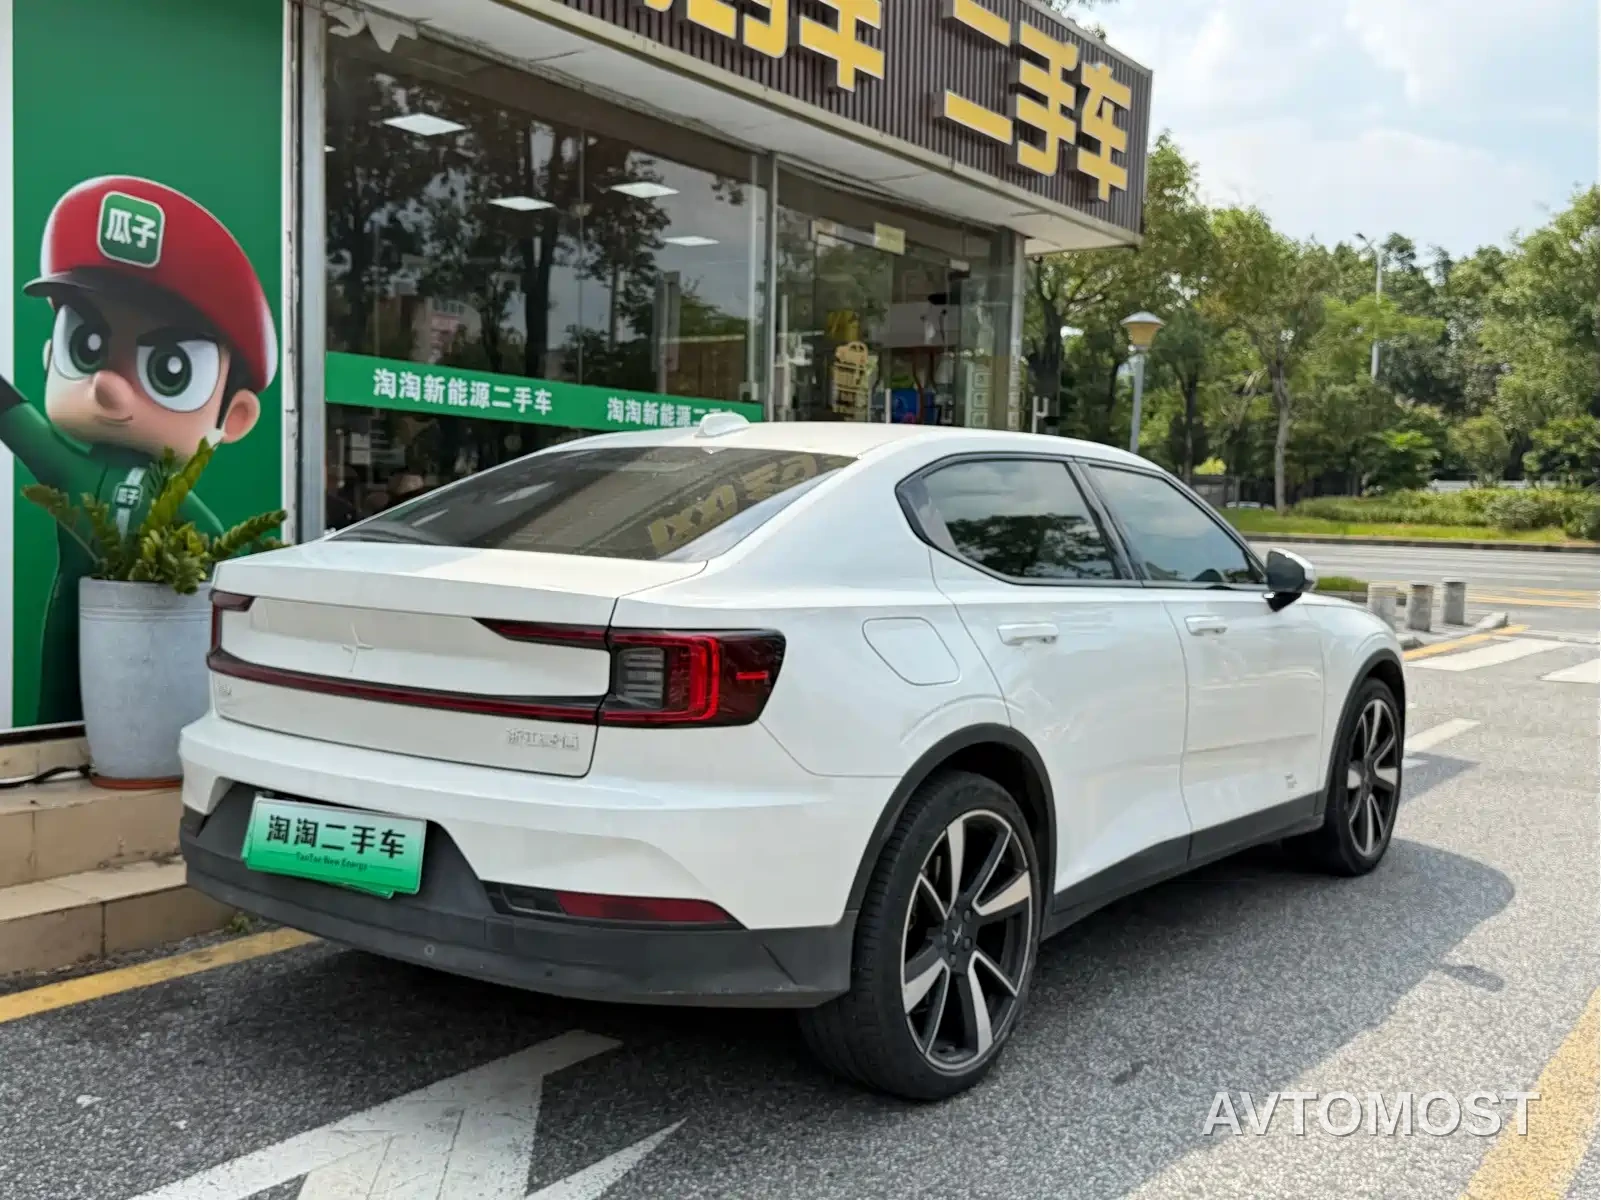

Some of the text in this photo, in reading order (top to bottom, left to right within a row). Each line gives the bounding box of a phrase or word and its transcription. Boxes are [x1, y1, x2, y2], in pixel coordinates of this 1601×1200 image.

[944, 0, 1132, 203] 二手车
[105, 207, 156, 249] 瓜子
[373, 368, 553, 416] 淘淘新能源二手车
[607, 396, 734, 427] 淘淘新能源二
[266, 814, 406, 859] 淘淘二手车
